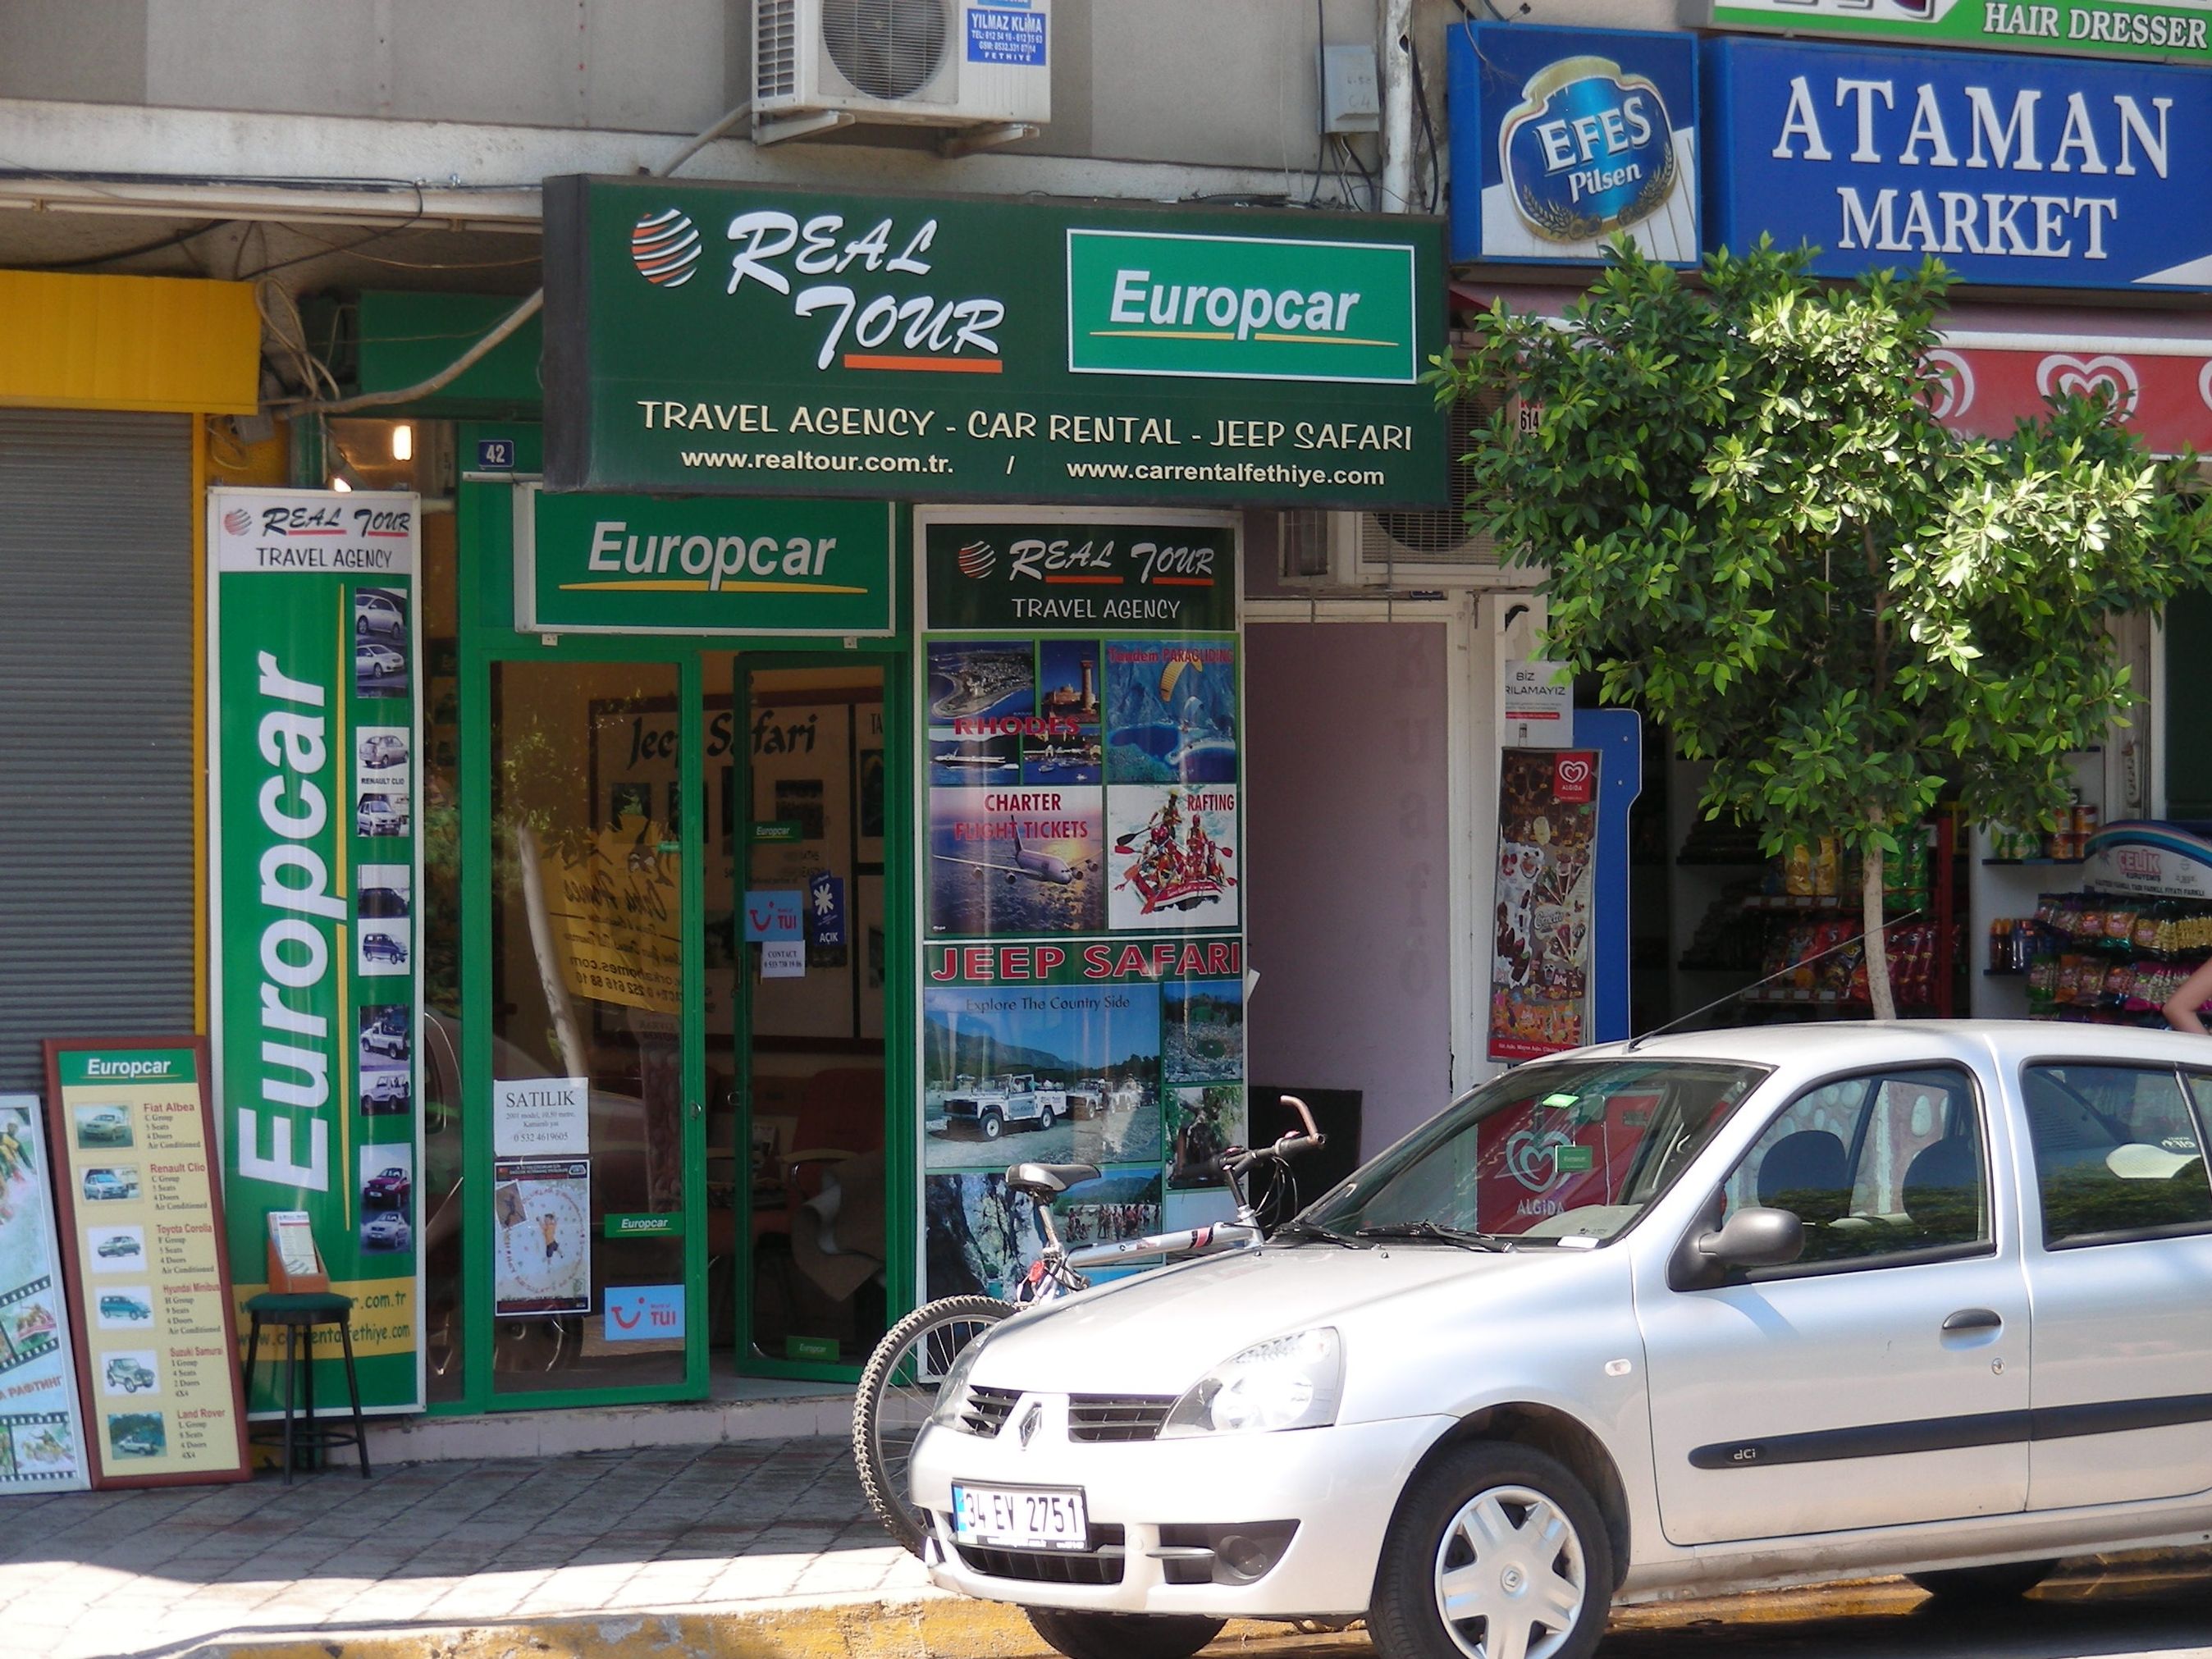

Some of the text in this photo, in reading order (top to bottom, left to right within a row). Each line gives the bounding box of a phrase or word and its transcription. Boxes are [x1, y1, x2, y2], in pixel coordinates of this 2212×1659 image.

[971, 12, 1008, 30] YILMAZ
[1982, 2, 2208, 51] HAIR DRESSER
[1535, 97, 1652, 174] EFES
[1772, 75, 2173, 180] ATAMAN
[1568, 162, 1642, 204] Pilsen
[1837, 186, 2118, 260] MARKET
[726, 210, 940, 295] REAL
[1109, 269, 1361, 341] Europcar
[794, 285, 1006, 371] TOUR
[637, 400, 779, 435] TRAVEL
[788, 406, 935, 439] AGENCY
[967, 412, 1036, 441] CAR
[1049, 416, 1181, 446] RENTAL
[1209, 419, 1287, 449] JEEP
[1294, 422, 1412, 451] SAFARI
[485, 444, 505, 464] 42
[1067, 459, 1385, 487] www.carrentalfethiye.com
[262, 507, 410, 538] REAL TOUR
[256, 547, 393, 569] TRAVEL AGENCY
[587, 520, 837, 592] Europcar
[1009, 538, 1214, 583] REAL TOUR
[1012, 598, 1181, 620] TRAVEL AGENCY
[1163, 648, 1233, 663] PARAGLIDING
[954, 715, 1081, 735] RHODES
[627, 717, 680, 770] Jee
[707, 711, 818, 757] Sfari
[985, 793, 1062, 812] CHARTER
[1187, 793, 1235, 811] RAFTING
[756, 826, 790, 836] Europcar
[955, 820, 1088, 842] FLIGHT TICKETS
[238, 650, 347, 1193] Europcar
[778, 915, 796, 930] TUI
[820, 932, 838, 944] AÇIK
[930, 943, 1241, 981] JEEP SAFARI
[967, 994, 1130, 1013] Explore The Country Side
[87, 1058, 171, 1078] Europcar
[144, 1103, 194, 1112] Fiat Albea
[506, 1090, 575, 1108] SATILIK
[521, 1133, 534, 1142] 532
[150, 1163, 206, 1173] Renault Clio
[157, 1224, 182, 1235] Toyota
[621, 1218, 668, 1230] Europcar
[651, 1311, 675, 1326] TUI
[177, 1409, 225, 1419] Land Rover
[1734, 1448, 1756, 1460] dCi
[966, 1493, 1077, 1533] 34 EV 2751
